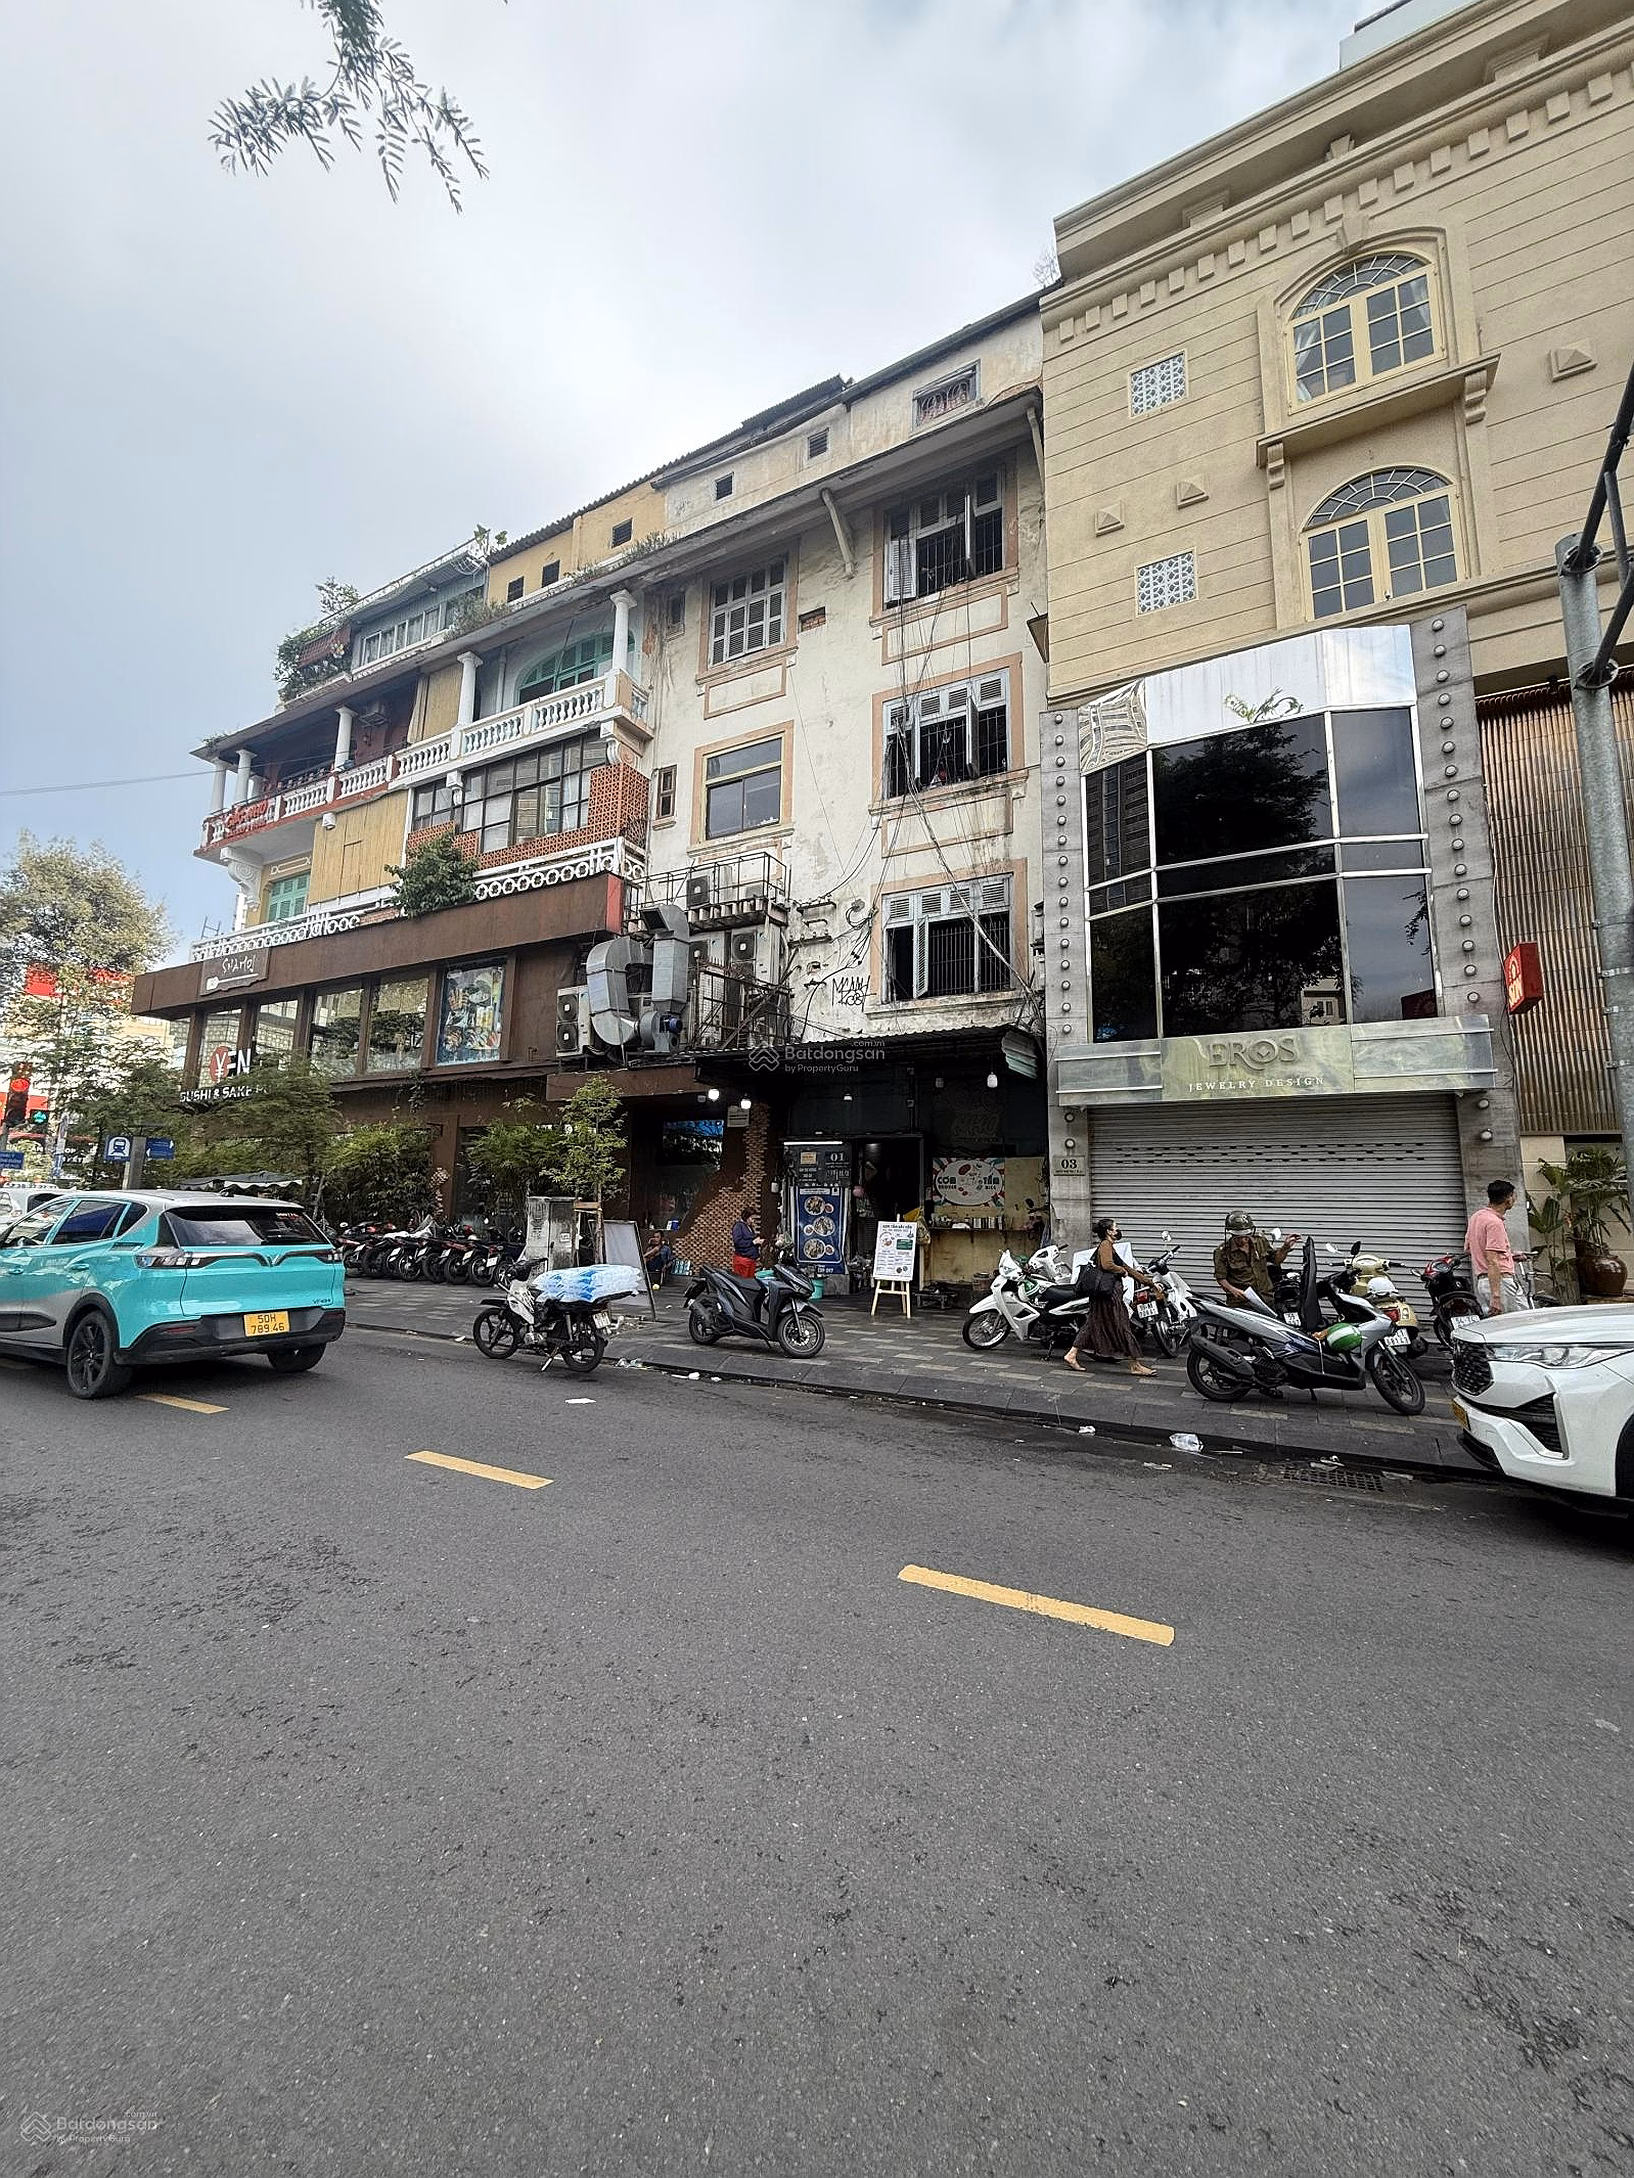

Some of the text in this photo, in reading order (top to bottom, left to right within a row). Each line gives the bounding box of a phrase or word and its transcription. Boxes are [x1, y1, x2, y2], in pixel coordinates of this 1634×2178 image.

[1208, 1037, 1298, 1072] EROS
[1188, 1077, 1324, 1093] JEWELRY DESIGN
[179, 1089, 212, 1103] SUSHI
[213, 1088, 220, 1100] &
[830, 1152, 845, 1162] 01
[1061, 1158, 1078, 1170] 03
[256, 1314, 277, 1324] 50H
